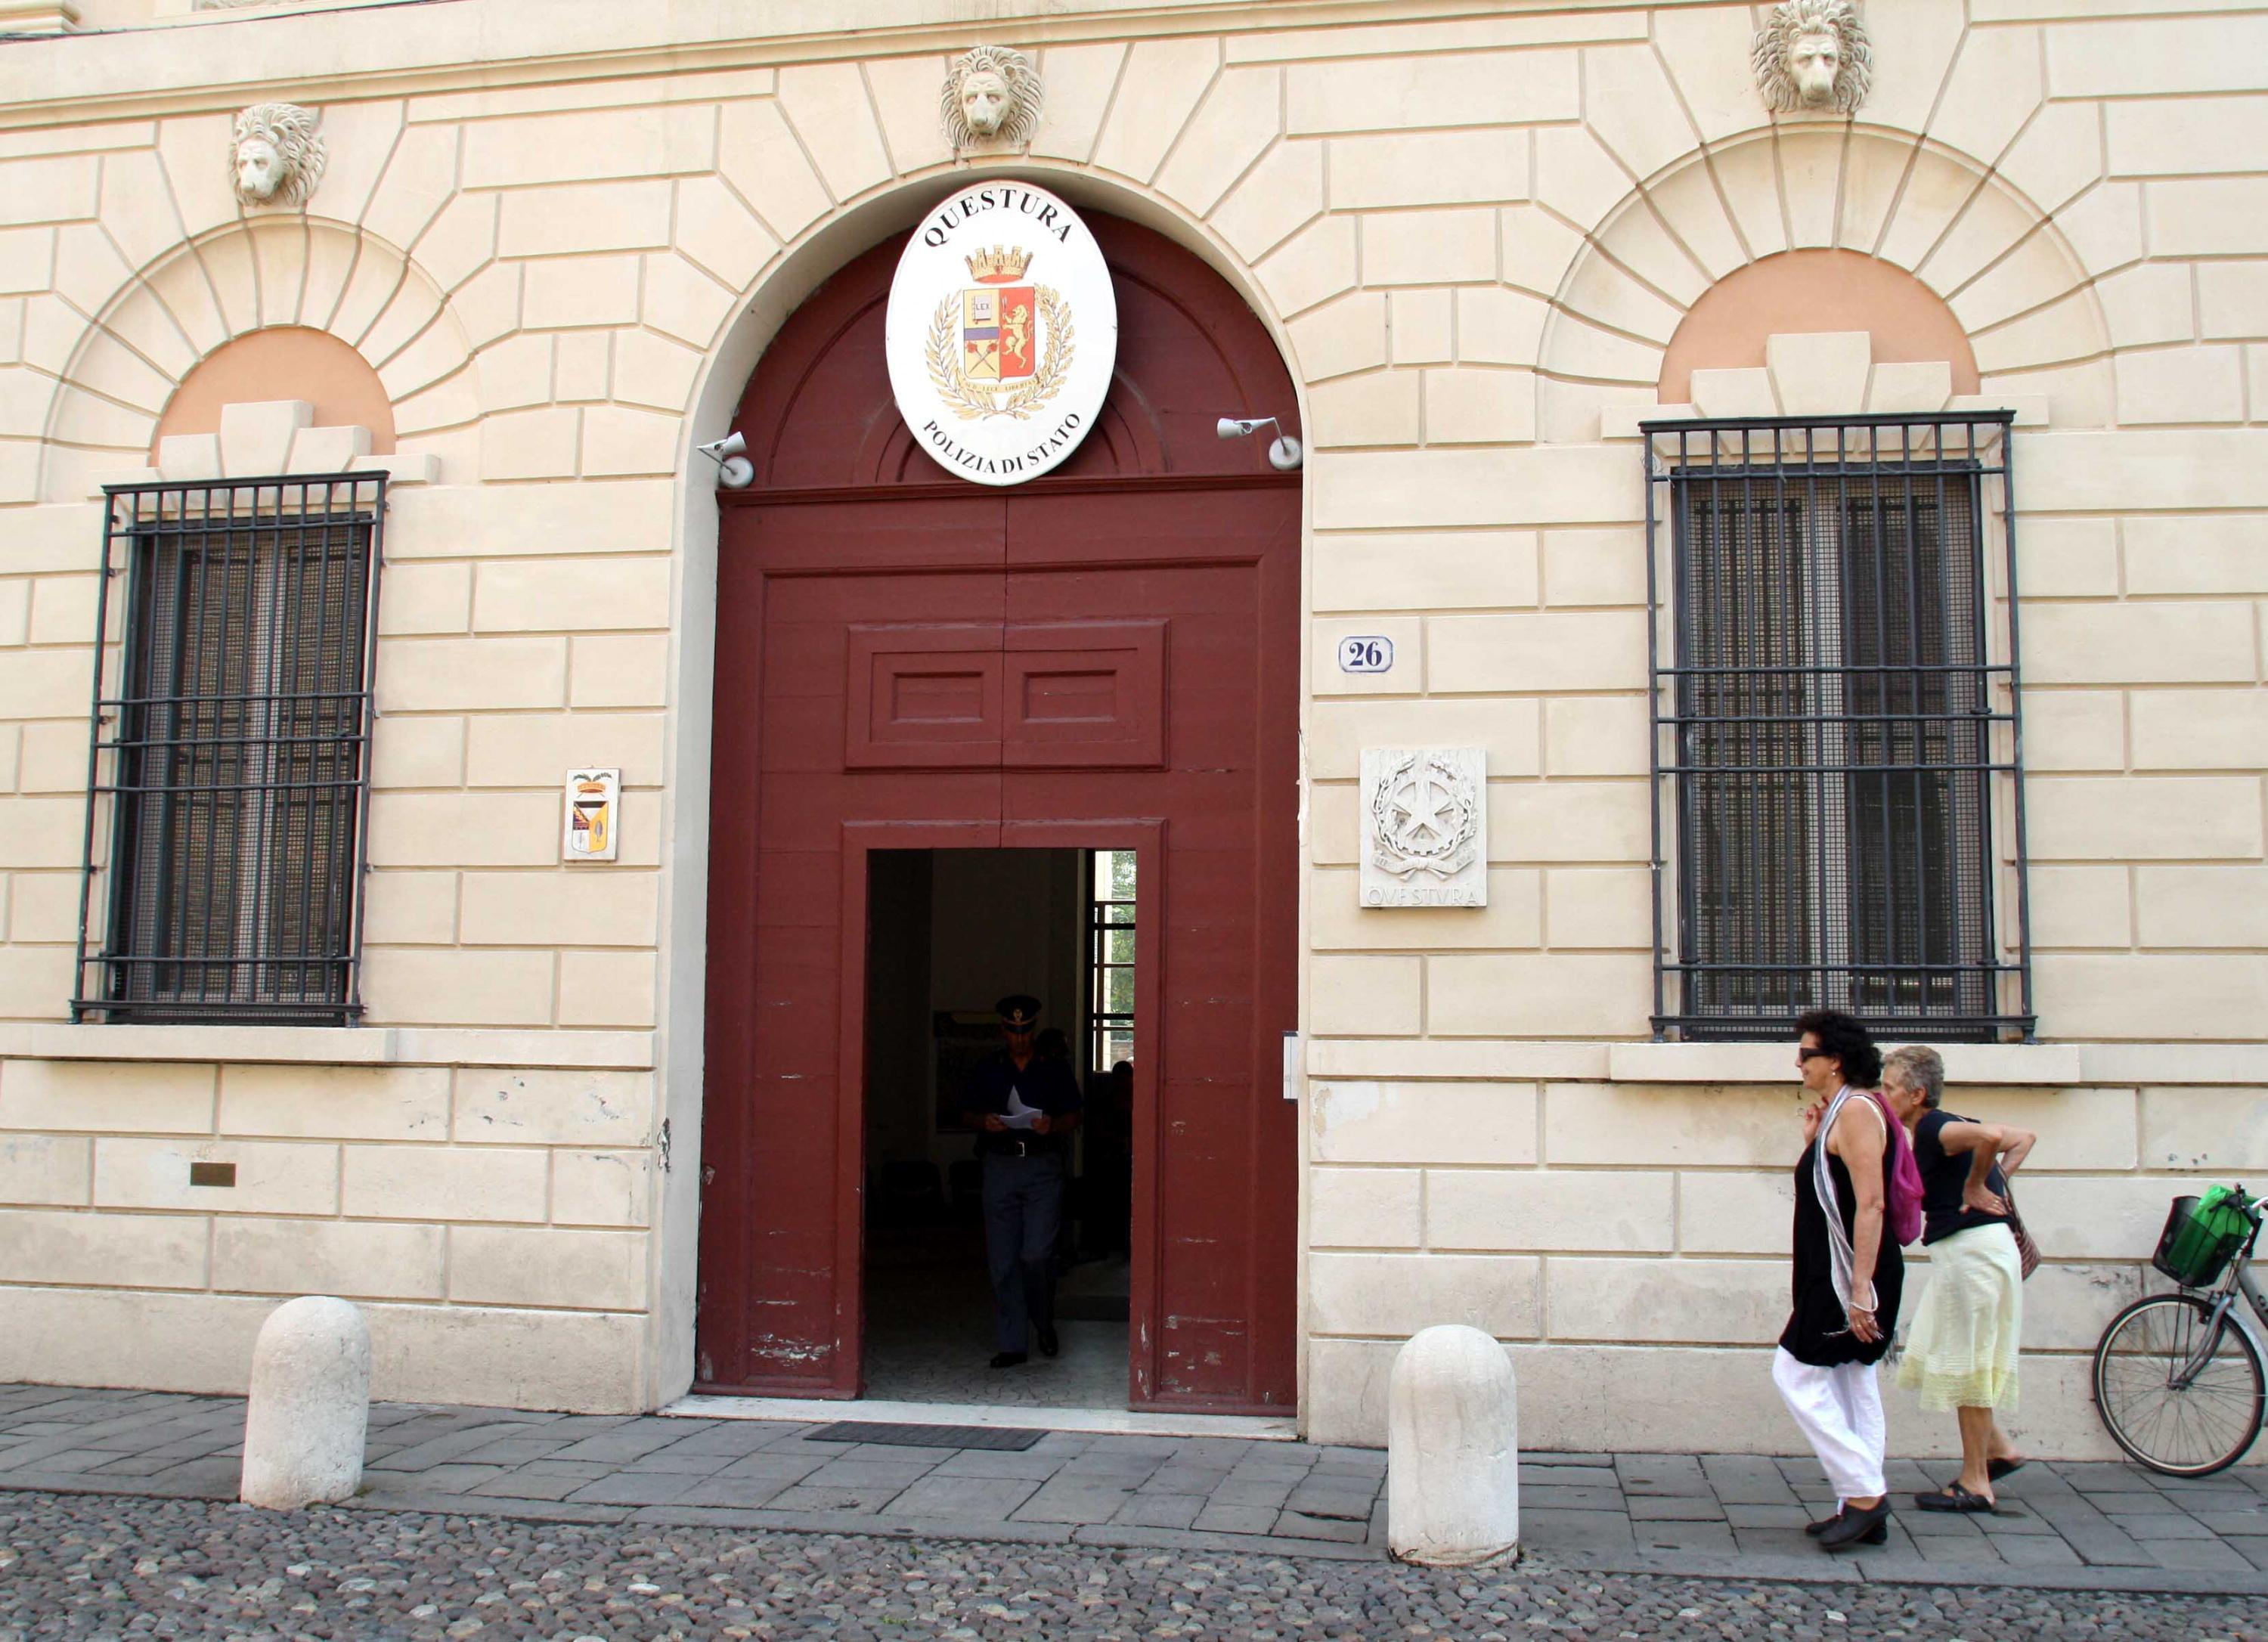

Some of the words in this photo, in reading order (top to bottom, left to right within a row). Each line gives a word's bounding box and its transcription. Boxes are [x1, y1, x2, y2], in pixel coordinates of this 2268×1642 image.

[925, 188, 1072, 247] QUESTURA
[923, 420, 997, 474] POLIZIA
[1001, 456, 1024, 474] DI
[1027, 413, 1081, 466] STATO
[1349, 641, 1383, 667] 26
